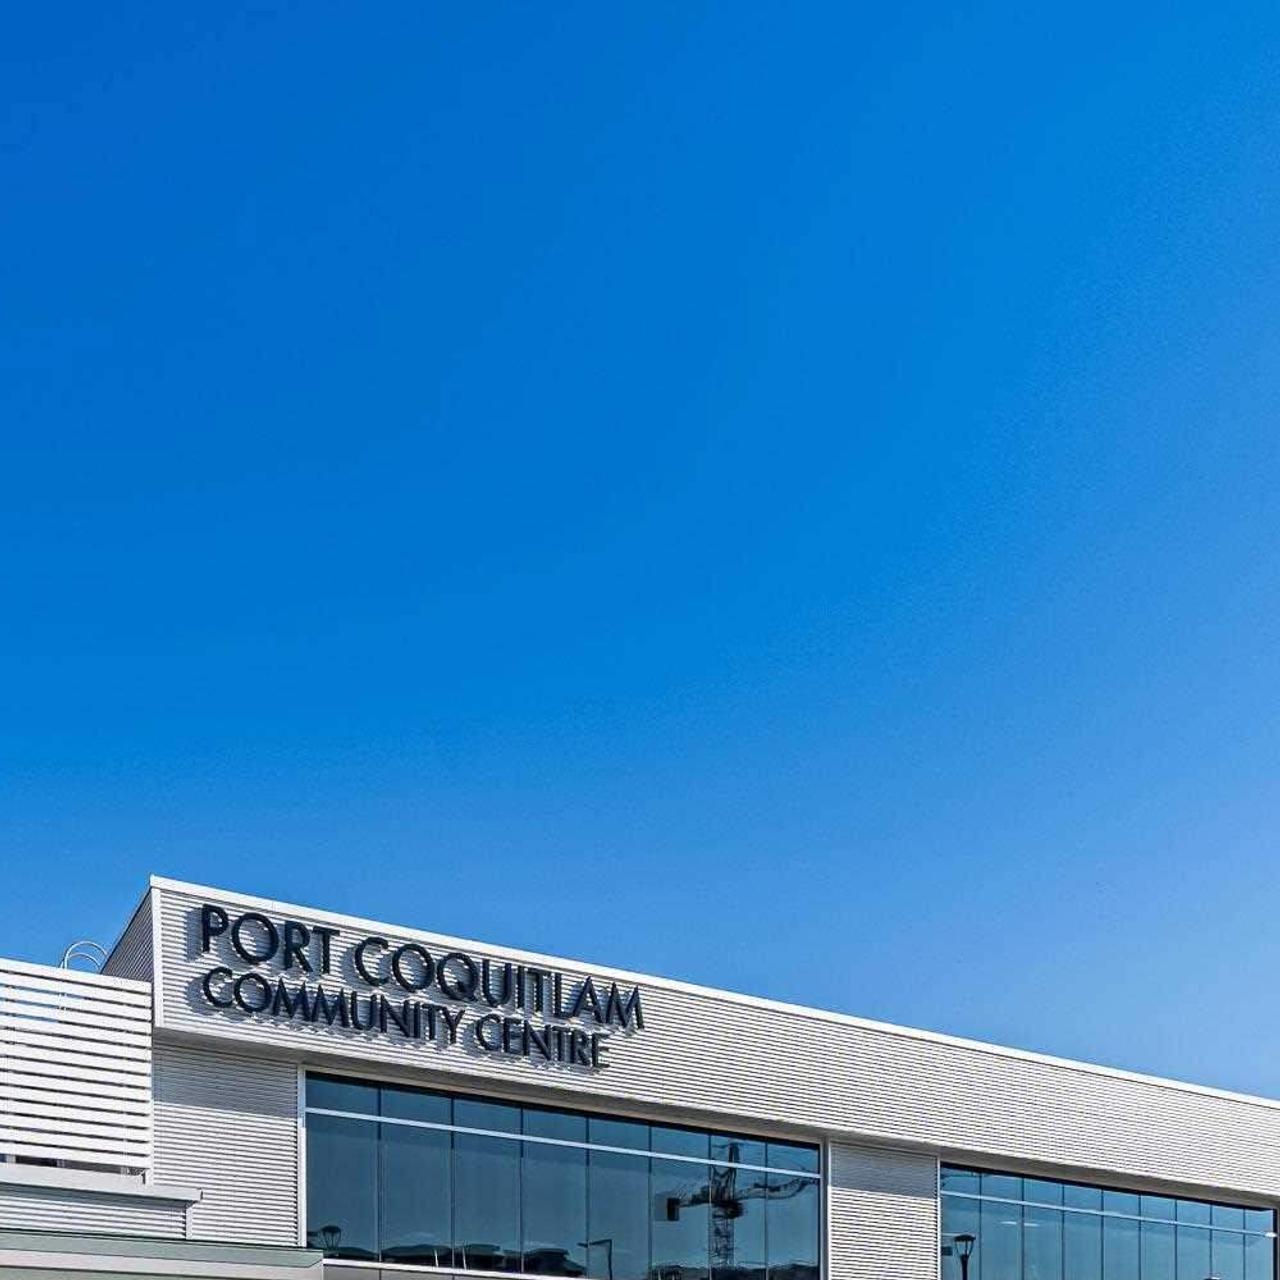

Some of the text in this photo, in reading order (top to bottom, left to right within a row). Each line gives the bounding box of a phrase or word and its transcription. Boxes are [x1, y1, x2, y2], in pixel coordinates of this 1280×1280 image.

[201, 903, 645, 1030] PORT COQUITLAM
[202, 966, 611, 1068] COMMUNITY CENTRE
